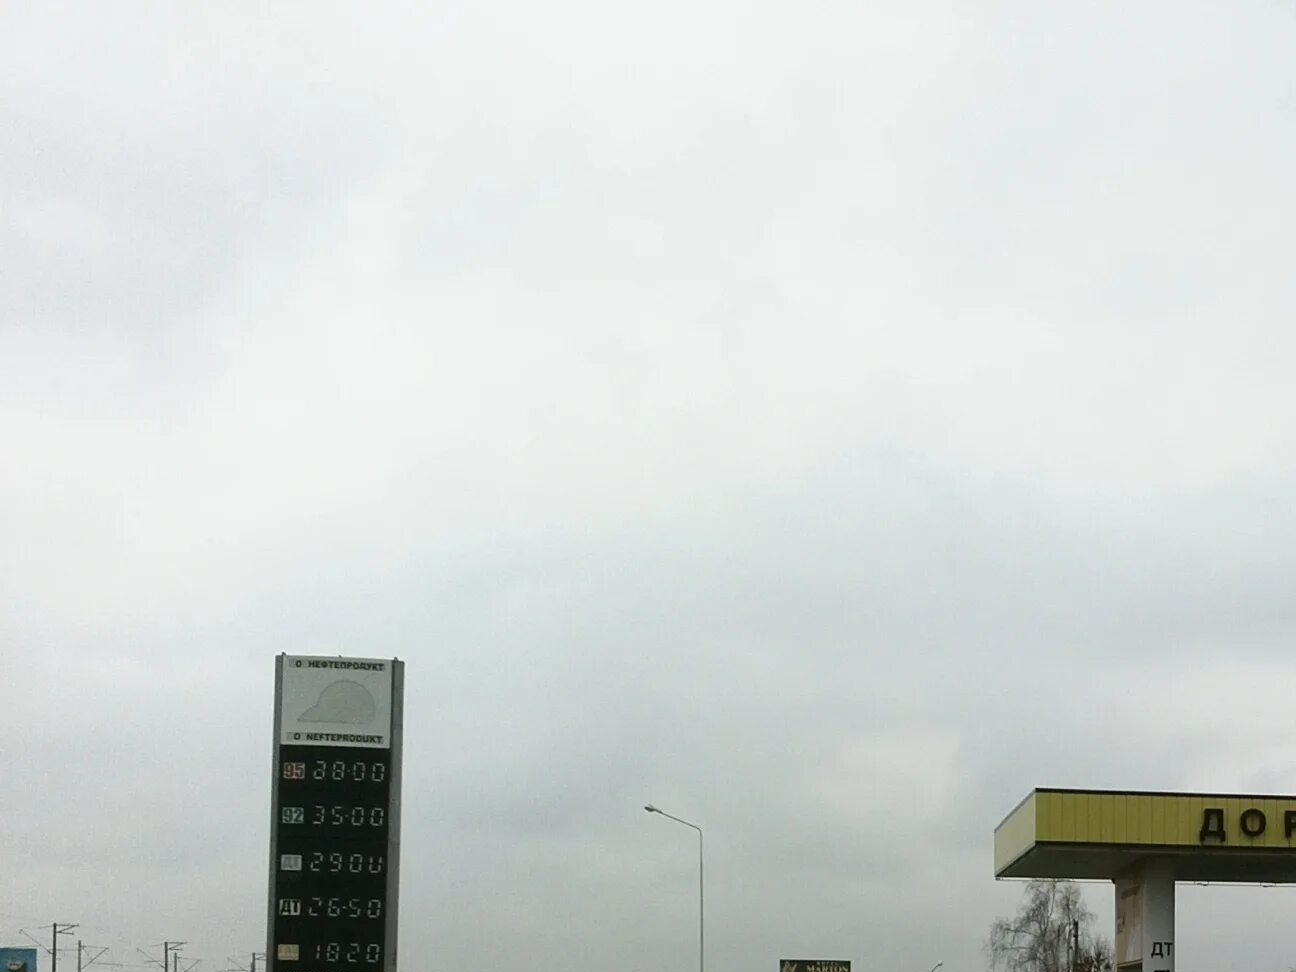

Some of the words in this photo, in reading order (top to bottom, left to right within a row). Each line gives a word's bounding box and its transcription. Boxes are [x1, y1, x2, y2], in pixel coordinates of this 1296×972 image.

[284, 763, 304, 779] 95
[282, 807, 304, 823] 92
[1151, 942, 1173, 958] ДТ
